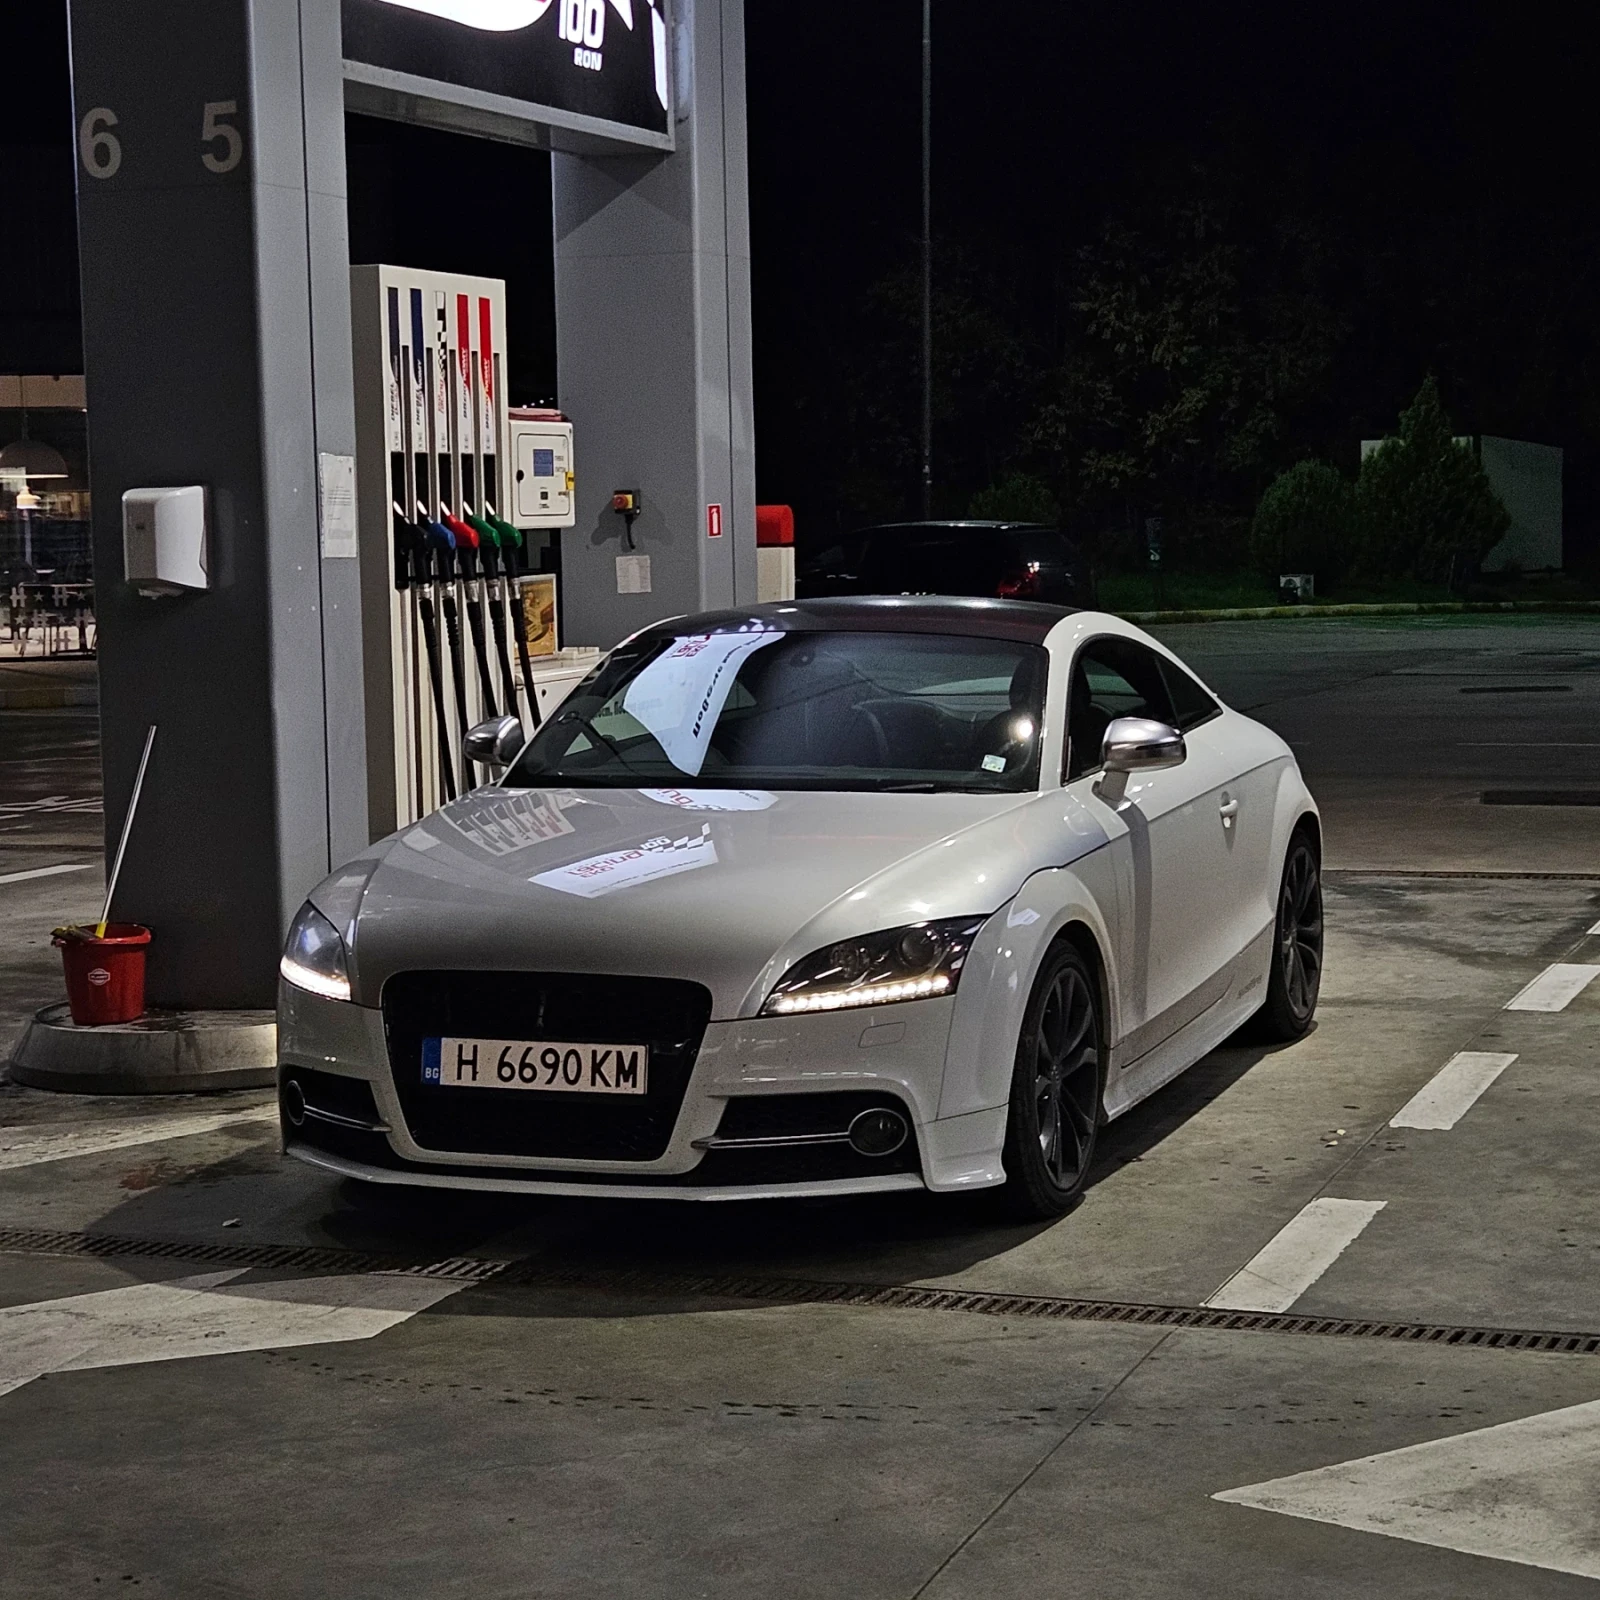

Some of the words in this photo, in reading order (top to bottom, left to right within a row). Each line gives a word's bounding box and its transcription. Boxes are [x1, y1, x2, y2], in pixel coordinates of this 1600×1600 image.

[558, 0, 605, 48] 100
[573, 47, 602, 71] RON
[80, 107, 122, 179] 6
[201, 100, 243, 173] 5
[425, 1067, 439, 1078] BG
[456, 1044, 478, 1081] H
